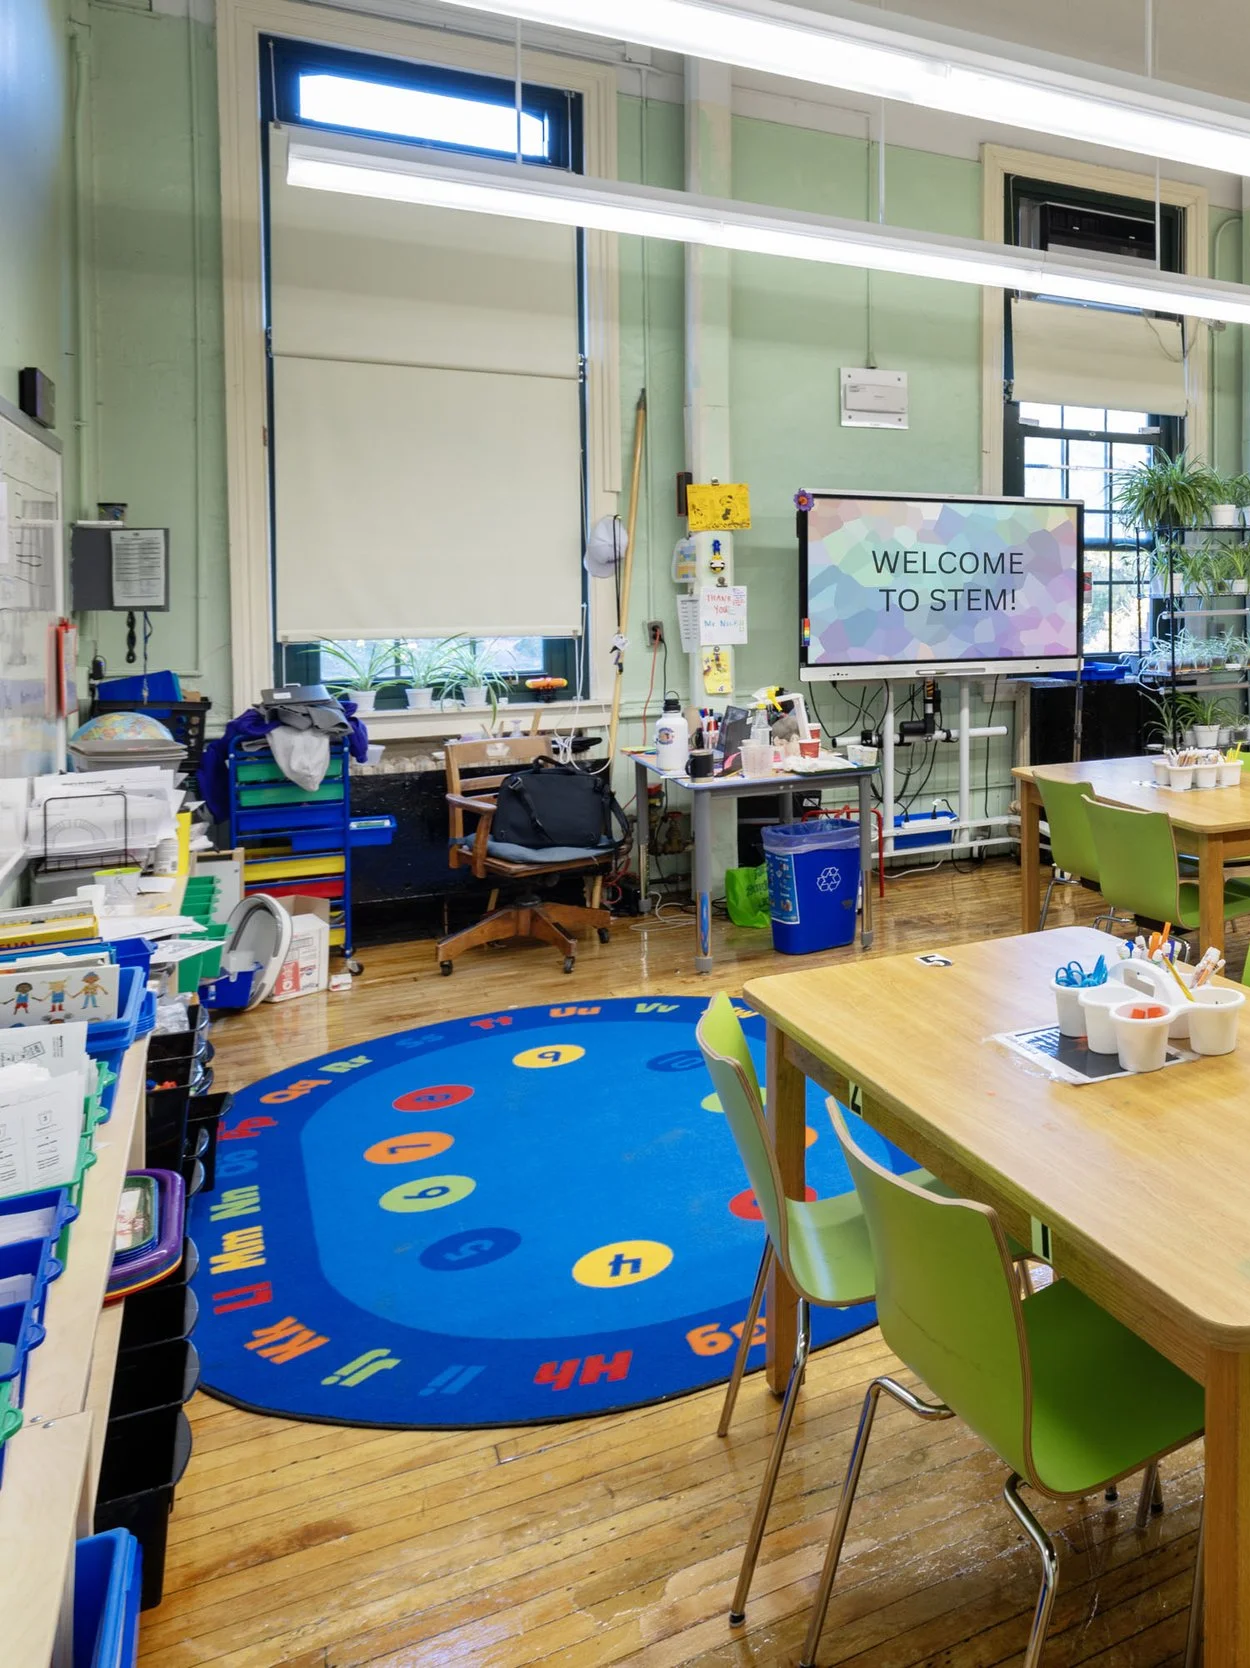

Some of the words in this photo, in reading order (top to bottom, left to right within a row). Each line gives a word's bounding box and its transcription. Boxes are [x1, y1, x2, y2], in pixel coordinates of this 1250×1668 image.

[872, 551, 1024, 574] WELCOME
[879, 589, 919, 612] TO
[930, 589, 1016, 611] STEM!
[550, 1006, 601, 1018] Uu
[210, 1185, 261, 1222] Nn
[209, 1225, 267, 1275] Mm
[607, 1253, 642, 1278] 4
[244, 1316, 330, 1364] Kk
[321, 1348, 402, 1388] Jj
[533, 1350, 633, 1391] Hh
